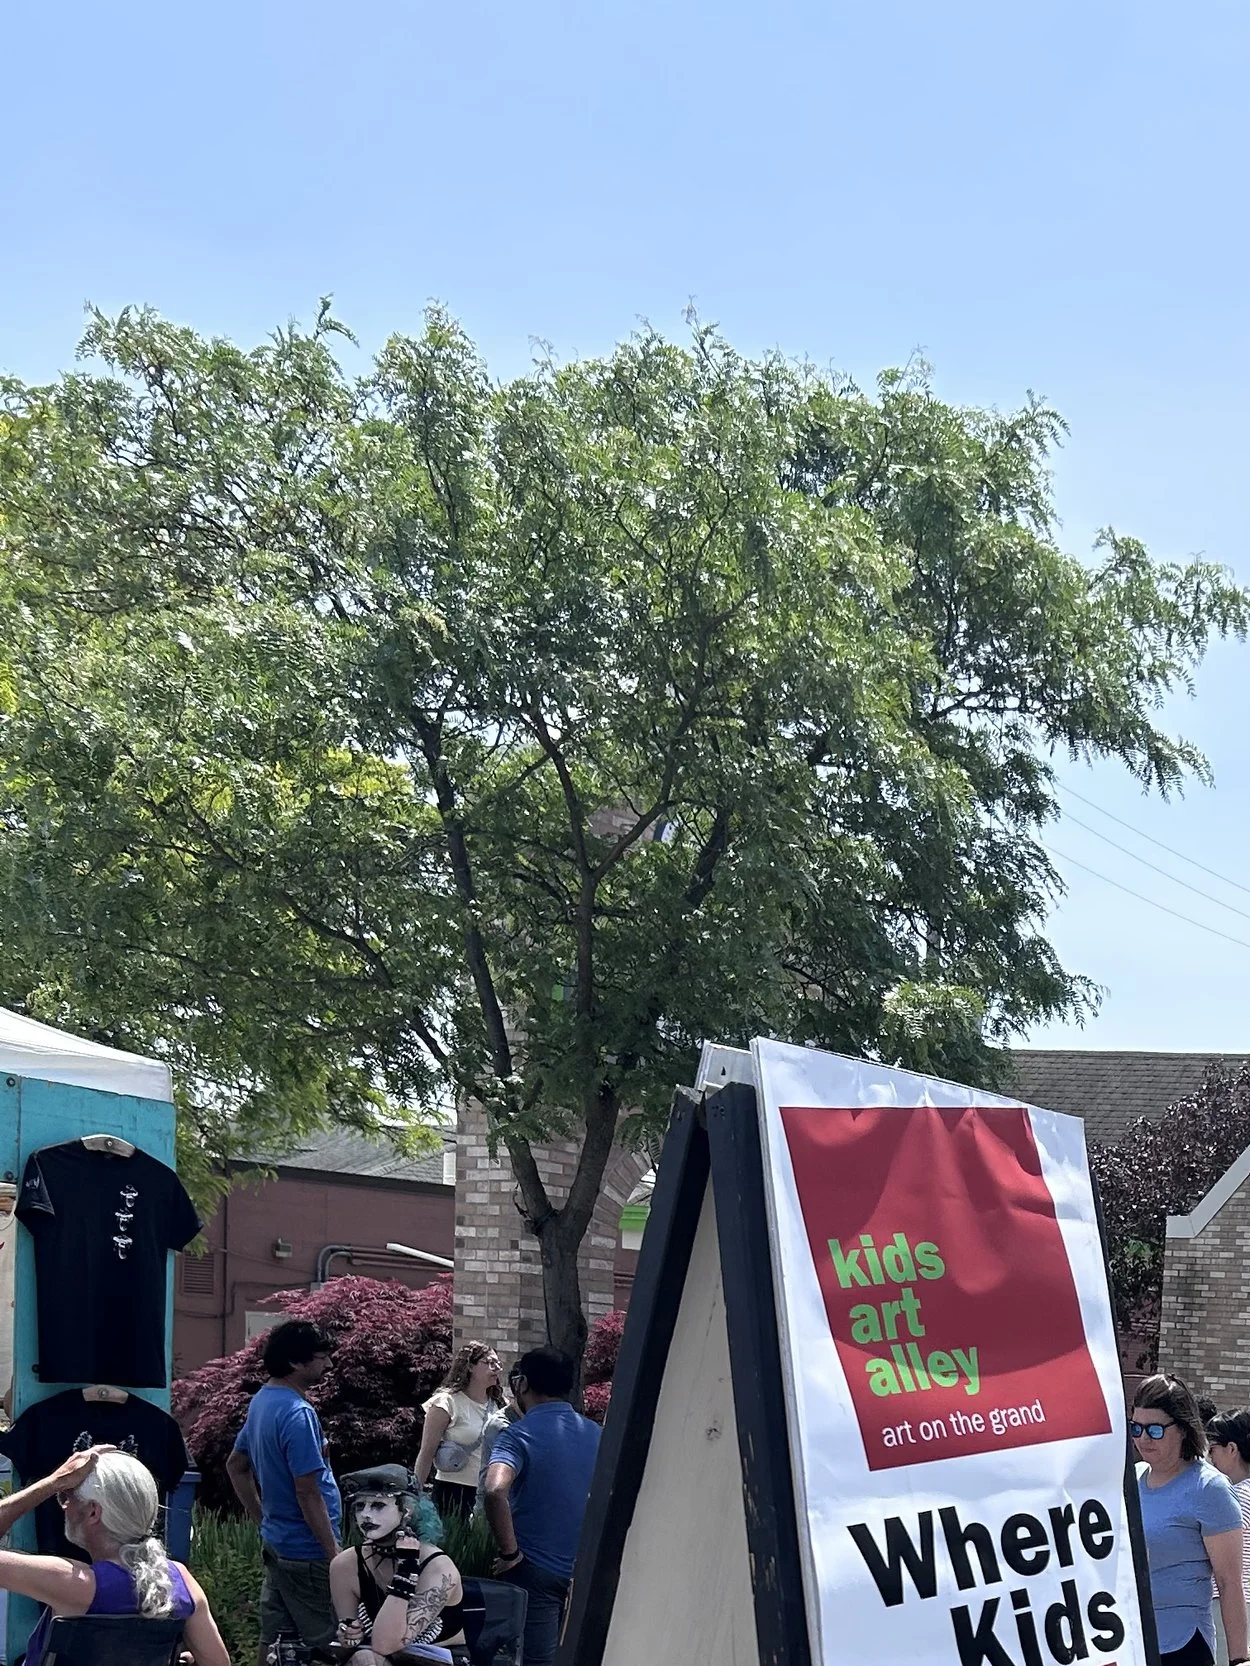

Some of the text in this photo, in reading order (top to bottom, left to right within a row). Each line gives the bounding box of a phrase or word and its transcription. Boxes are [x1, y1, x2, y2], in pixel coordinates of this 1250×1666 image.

[828, 1232, 945, 1288] kids
[850, 1288, 925, 1344] art
[866, 1342, 980, 1396] alley
[881, 1398, 1047, 1447] art on the grand
[846, 1498, 1115, 1608] Where
